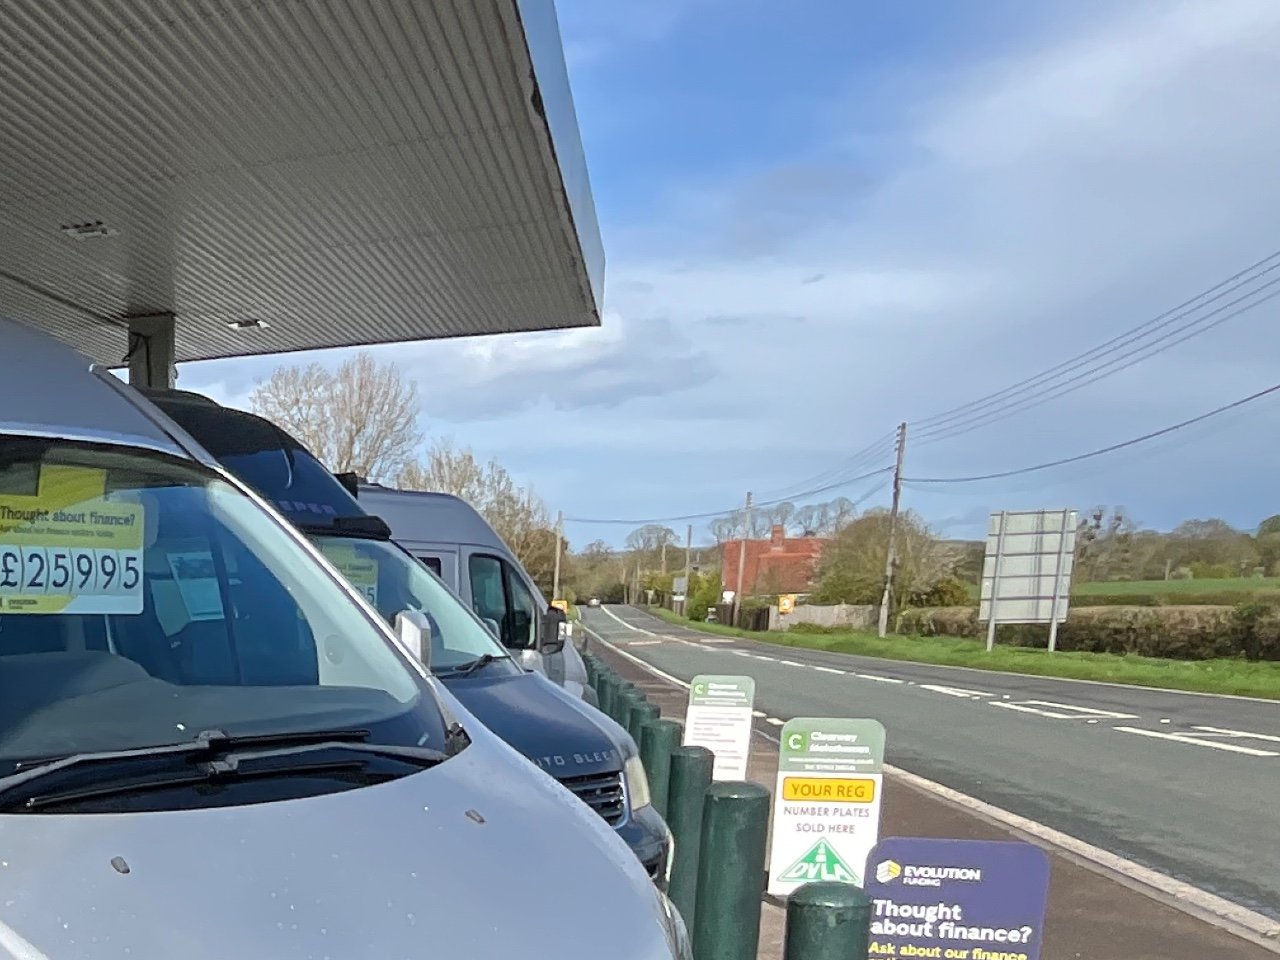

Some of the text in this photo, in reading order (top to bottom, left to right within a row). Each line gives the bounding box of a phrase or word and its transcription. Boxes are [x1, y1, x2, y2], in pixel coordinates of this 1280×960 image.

[0, 506, 135, 526] Thought about finance?
[0, 551, 140, 590] £25995
[788, 734, 802, 750] C
[792, 783, 865, 798] YOUR REG
[783, 806, 870, 818] NUMBER PLATES
[796, 822, 855, 834] SOLD HERE
[904, 866, 981, 881] EVOLUTION
[873, 899, 962, 923] Thought
[870, 918, 1032, 943] about finance?
[868, 941, 896, 955] Ask
[899, 942, 941, 958] about
[944, 949, 969, 960] our
